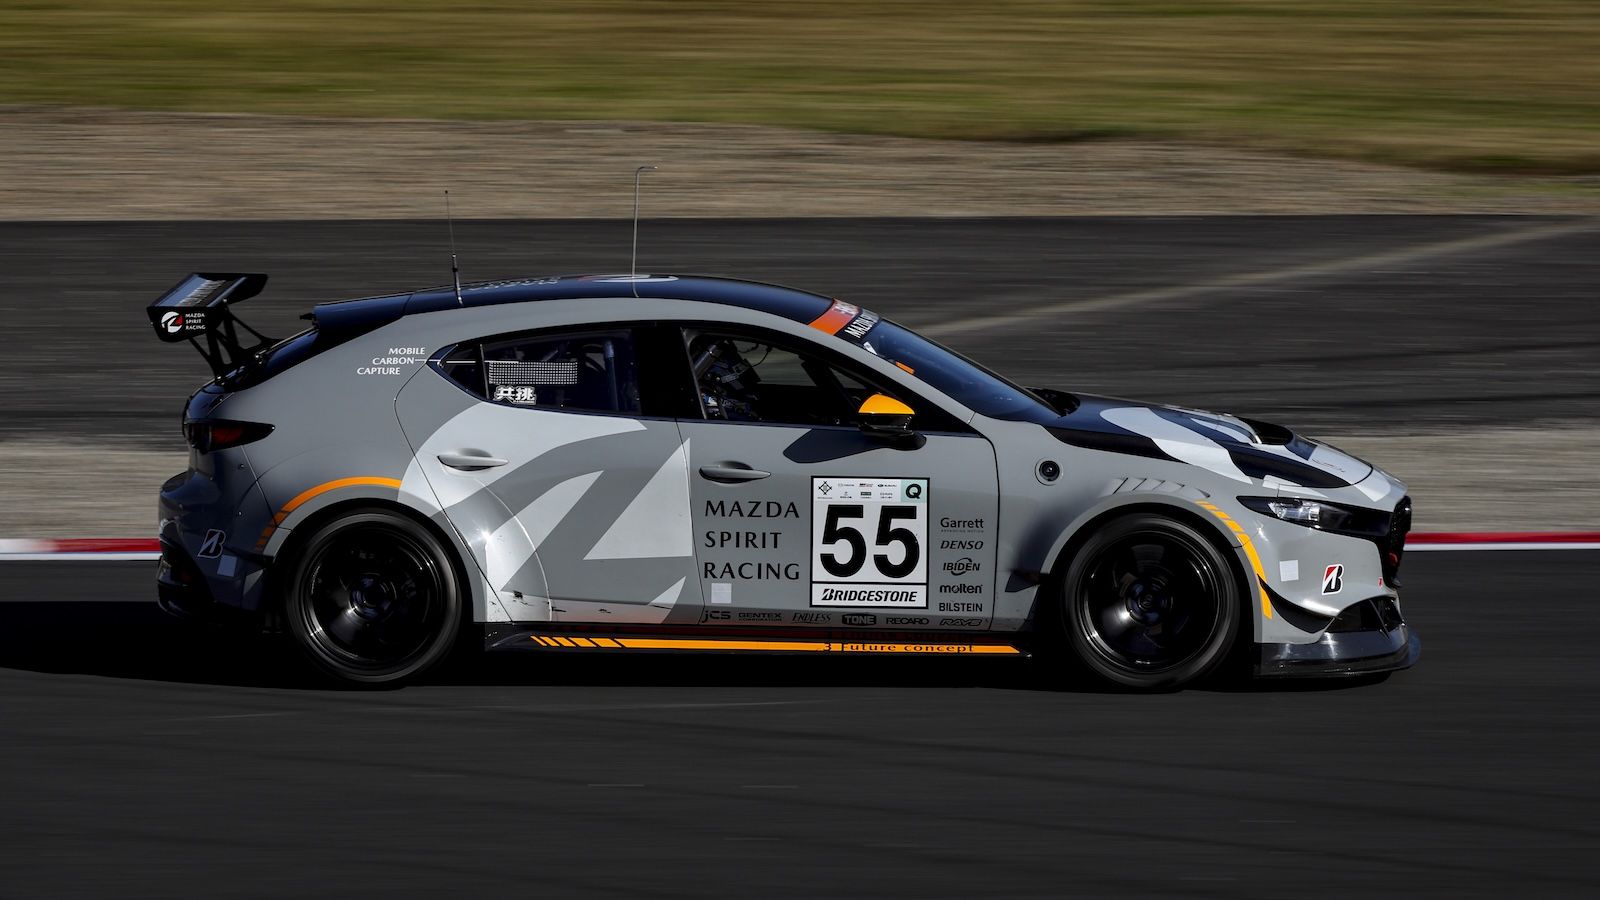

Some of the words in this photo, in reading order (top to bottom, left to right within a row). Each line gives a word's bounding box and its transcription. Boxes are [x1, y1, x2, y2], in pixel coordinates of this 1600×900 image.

[388, 347, 426, 355] MOBILE
[372, 357, 415, 365] CARBON
[356, 367, 401, 375] CAPTURE
[496, 386, 536, 401] 共挑
[905, 483, 922, 499] Q
[704, 500, 800, 518] MAZDA
[940, 517, 984, 528] Garrett
[705, 530, 782, 549] SPIRIT
[820, 504, 920, 578] 55
[940, 540, 984, 550] DENSO
[703, 562, 800, 580] RACING
[943, 562, 981, 571] IBIDEN
[940, 583, 983, 594] molten
[821, 588, 918, 602] BRIDGESTONE
[939, 602, 983, 612] BILSTEIN
[792, 612, 832, 625] ENDLESS
[844, 615, 875, 625] TONE
[886, 617, 930, 625] RECARO
[940, 618, 983, 627] RAYS
[841, 643, 897, 652] Future
[904, 644, 974, 653] concept
